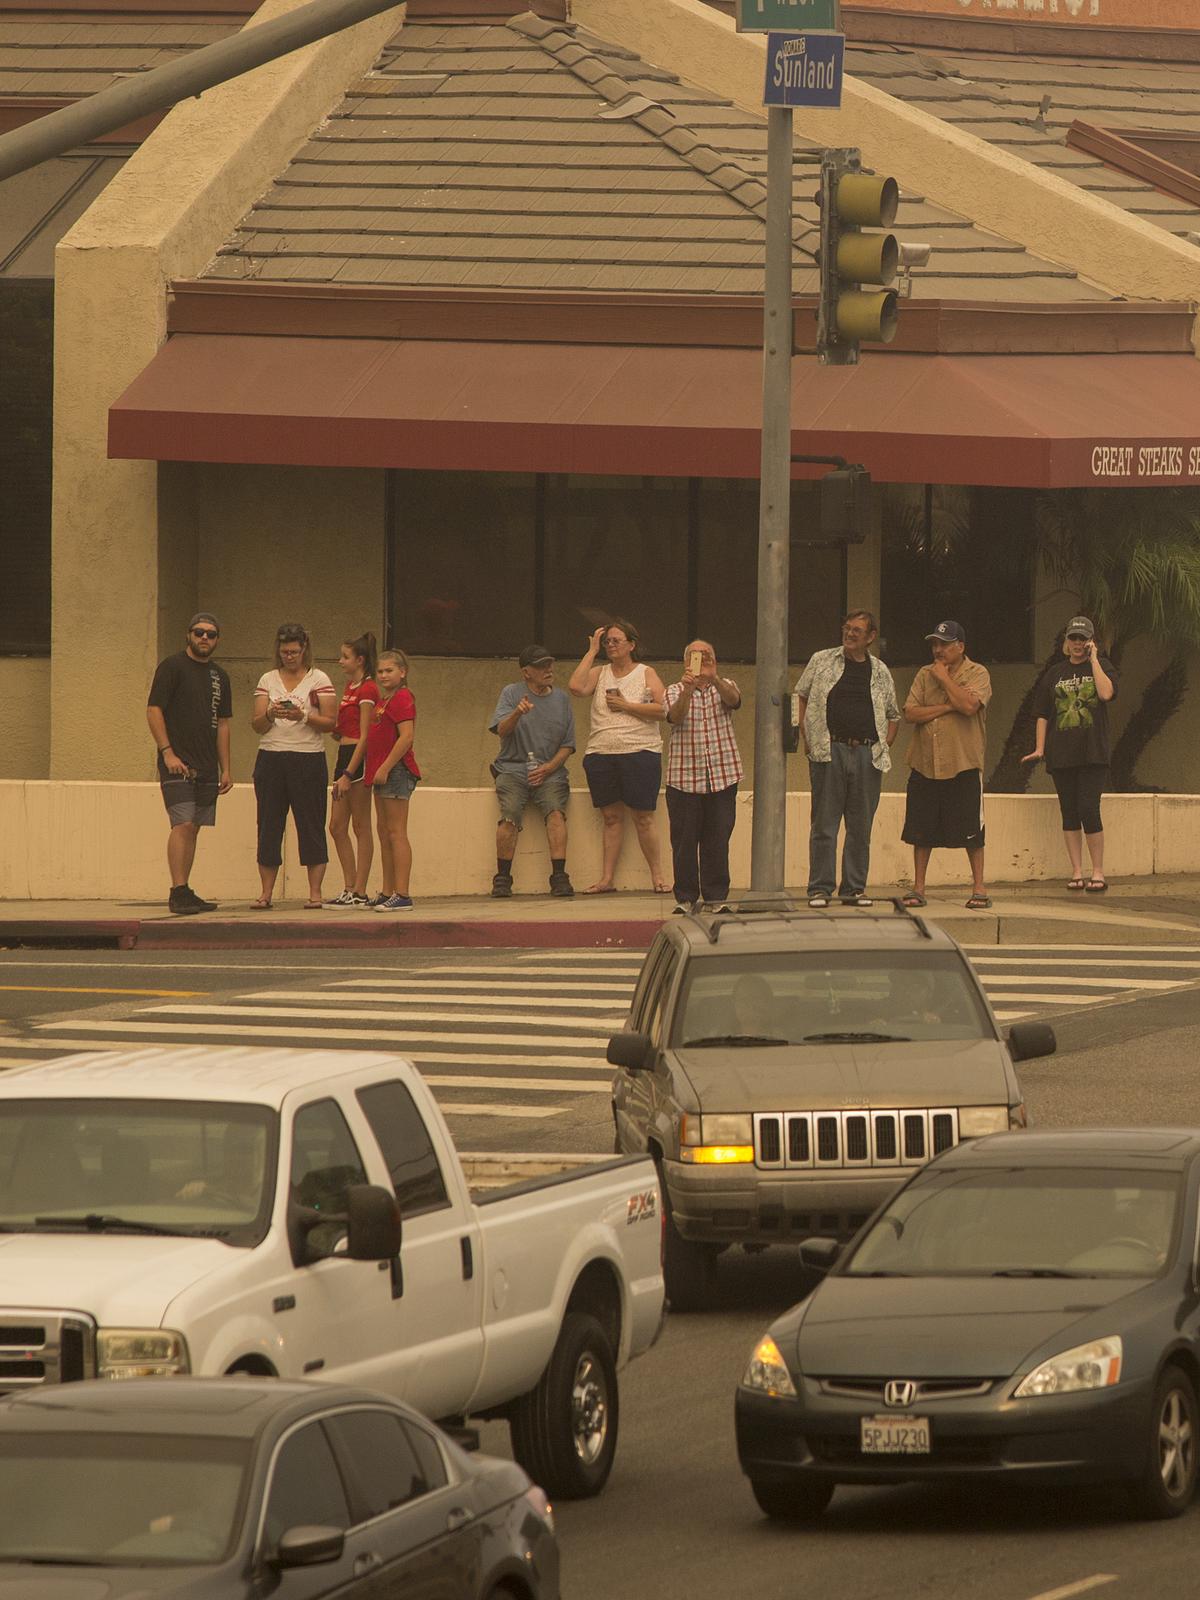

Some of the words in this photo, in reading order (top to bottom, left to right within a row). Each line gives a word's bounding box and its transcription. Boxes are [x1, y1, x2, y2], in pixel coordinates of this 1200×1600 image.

[773, 50, 835, 89] Sunland
[1091, 446, 1133, 476] GREAT
[1138, 446, 1183, 476] STEAKS
[628, 1190, 656, 1216] FX4
